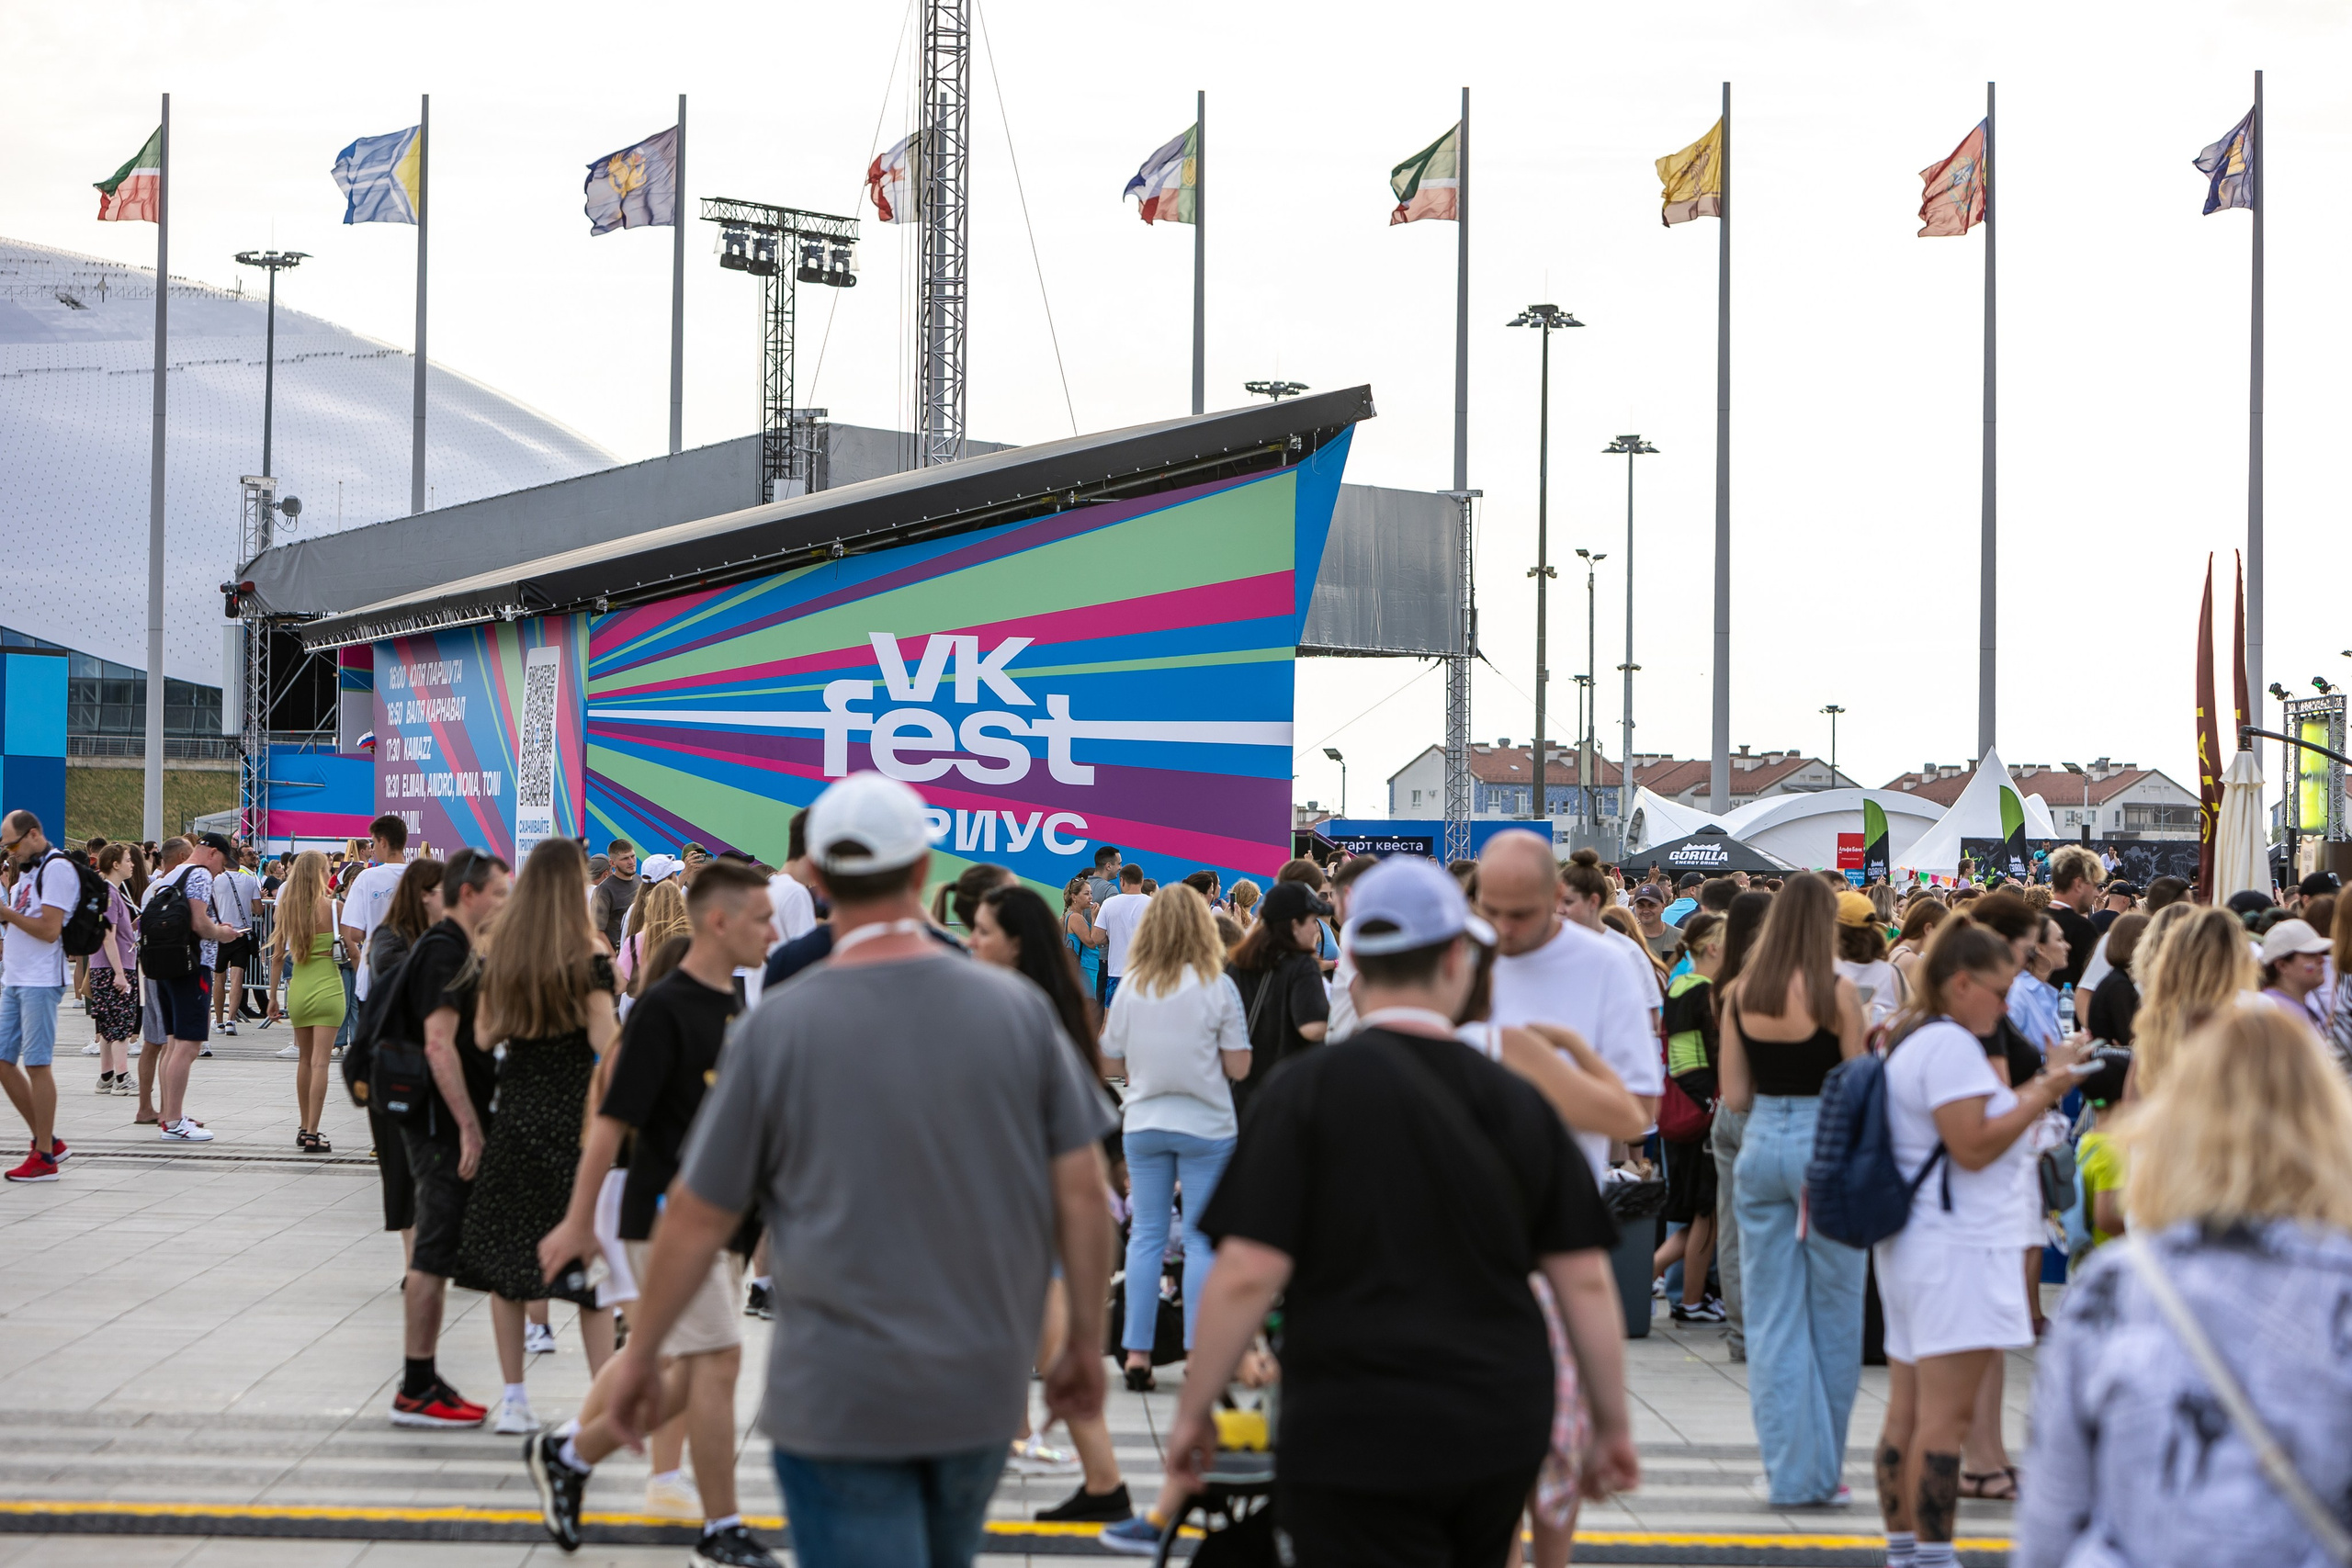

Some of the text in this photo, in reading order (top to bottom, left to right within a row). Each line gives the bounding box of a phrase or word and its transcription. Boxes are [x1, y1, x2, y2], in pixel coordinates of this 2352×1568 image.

[389, 660, 462, 689] 16:00 ЮЛЯ ПАРШУТА
[868, 632, 1036, 706] VK
[387, 696, 467, 726] 16:50 ВАЛЯ КАРНАВАЛ
[822, 679, 1095, 785] fest
[386, 736, 432, 761] 17:30 KAMAZZ
[385, 773, 400, 798] 18:30
[922, 807, 1089, 855] РИУС
[1375, 841, 1423, 851] квеста
[1668, 851, 1728, 862] GORILLA
